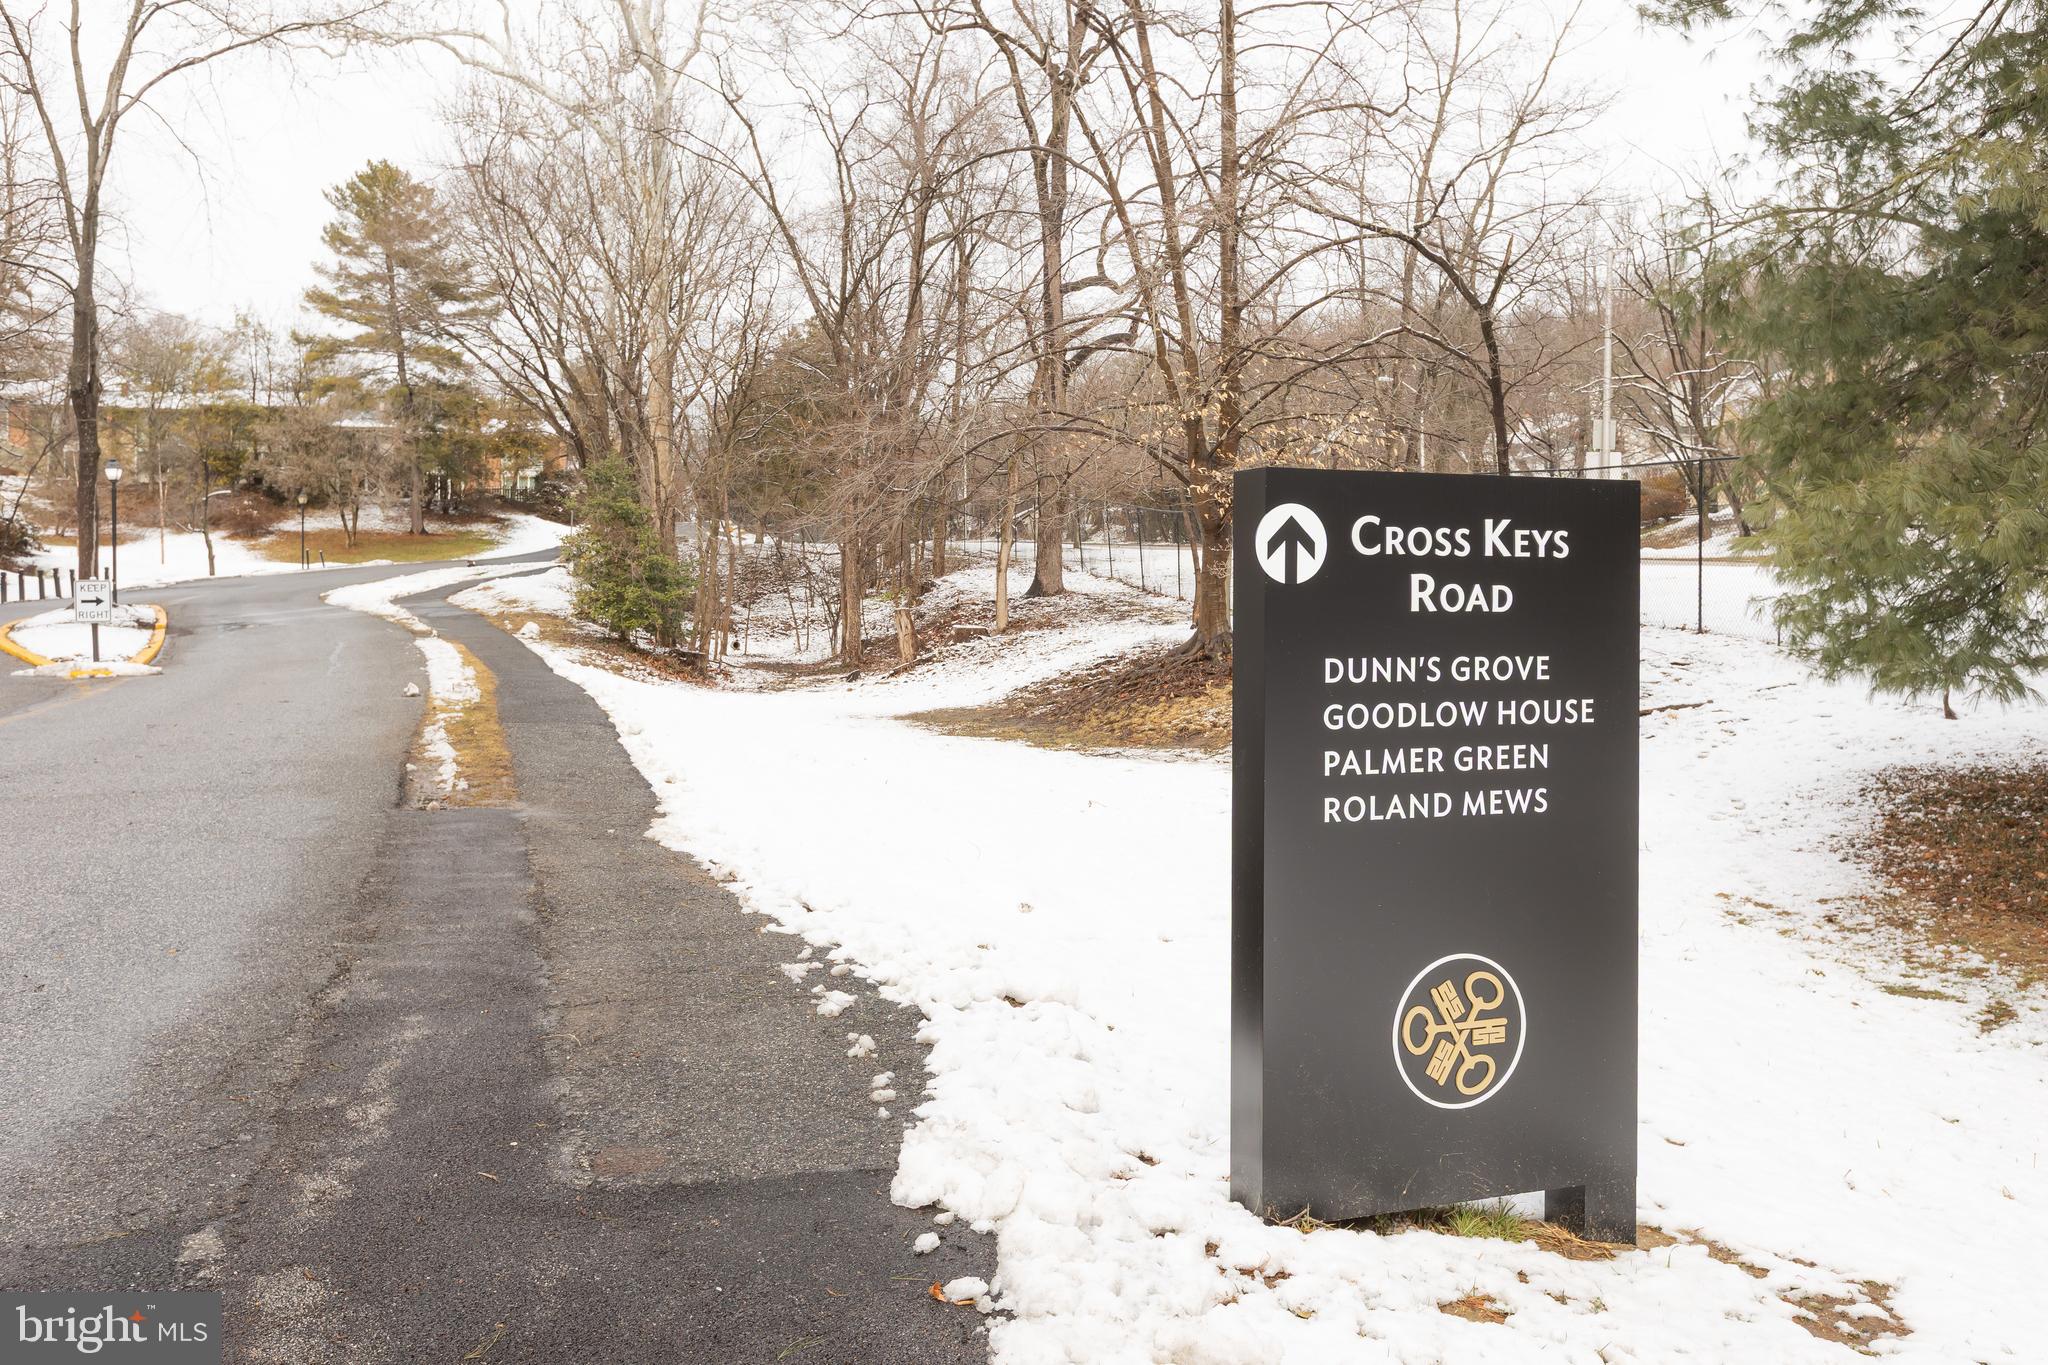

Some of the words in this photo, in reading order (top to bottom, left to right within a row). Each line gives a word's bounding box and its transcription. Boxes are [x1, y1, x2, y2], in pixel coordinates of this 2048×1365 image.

[79, 584, 107, 592] KEEP
[78, 610, 109, 619] RIGHT
[1324, 656, 1441, 684] DUNN'S
[1450, 655, 1550, 682] GROVE
[1323, 700, 1489, 731] GOODLOW
[1497, 698, 1595, 726] HOUSE
[1324, 747, 1445, 777] PALMER
[1453, 743, 1549, 772] GREEN
[1323, 792, 1453, 823] ROLAND
[1462, 787, 1548, 817] MEWS
